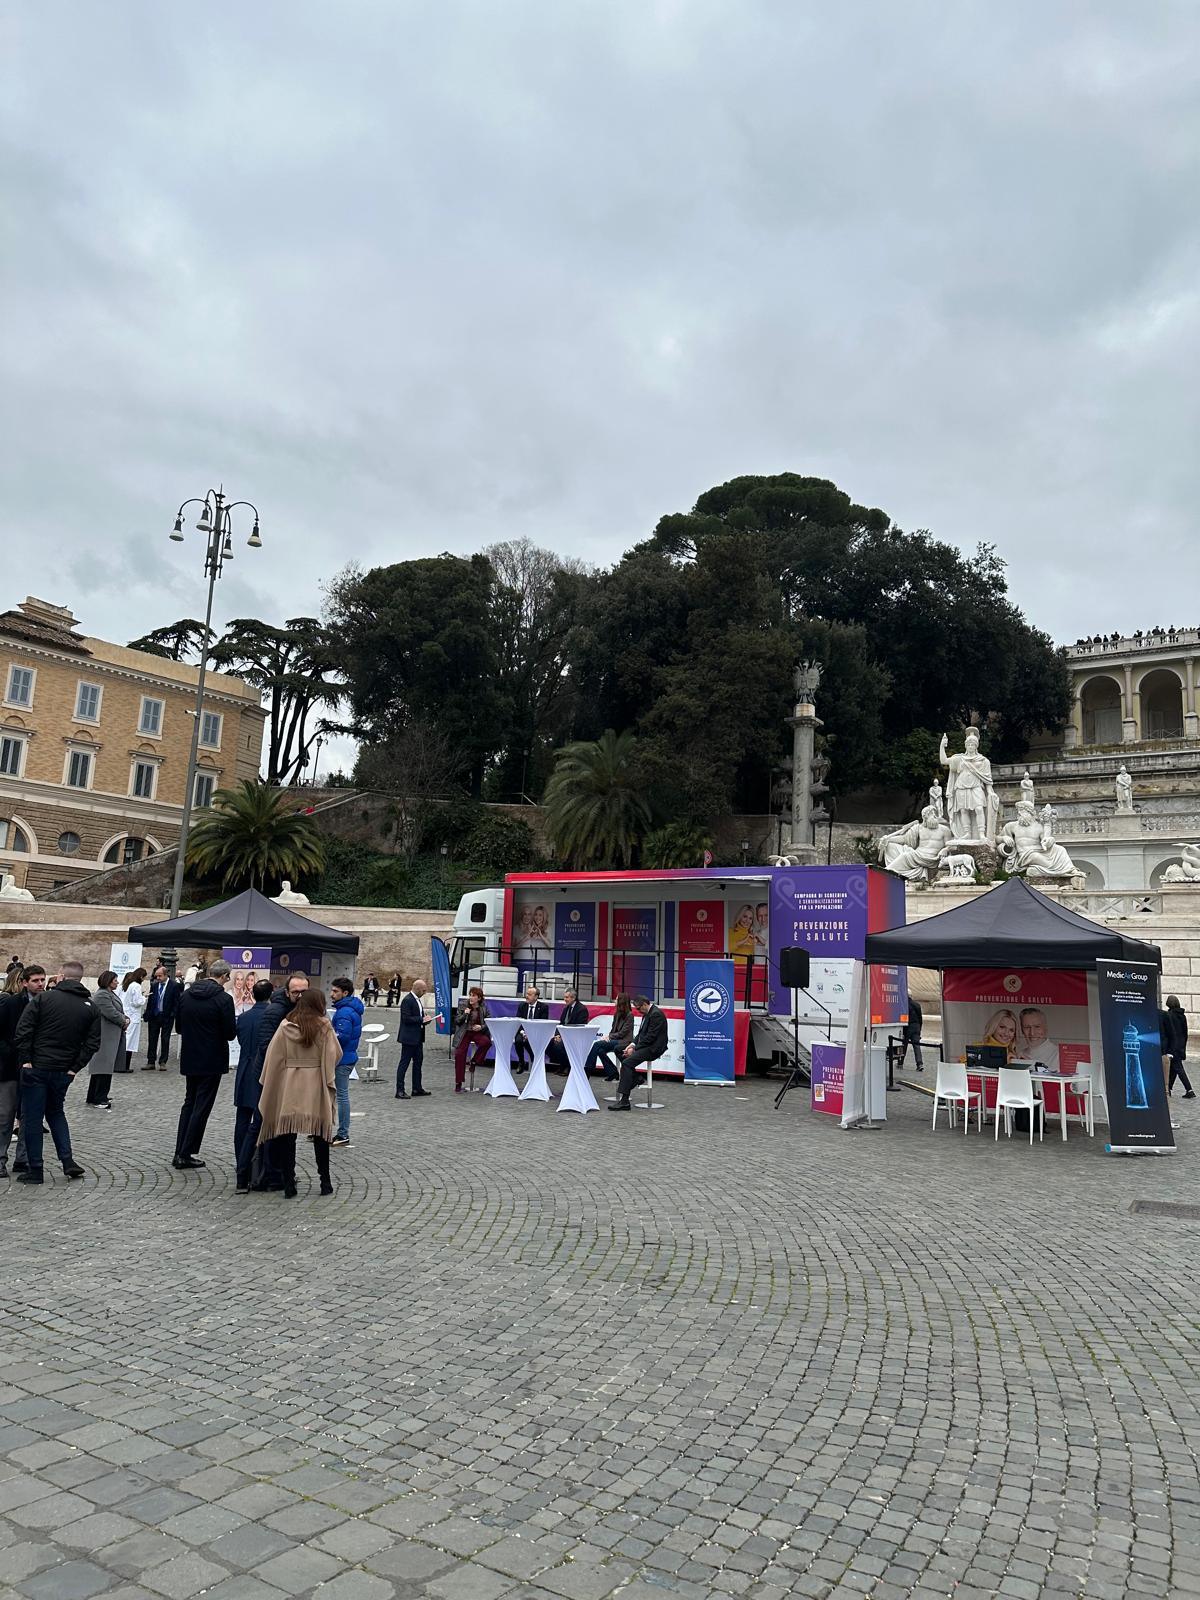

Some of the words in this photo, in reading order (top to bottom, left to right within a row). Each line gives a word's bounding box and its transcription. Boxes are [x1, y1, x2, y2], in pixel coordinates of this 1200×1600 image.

[793, 921, 849, 930] PREVENZIONE
[793, 930, 798, 941] È
[806, 932, 849, 941] SALUTE
[1106, 970, 1148, 982] MedicAirGroup
[975, 995, 1018, 1003] PREVENZIONE
[1028, 996, 1053, 1004] SALUTE
[828, 1073, 843, 1081] SALU
